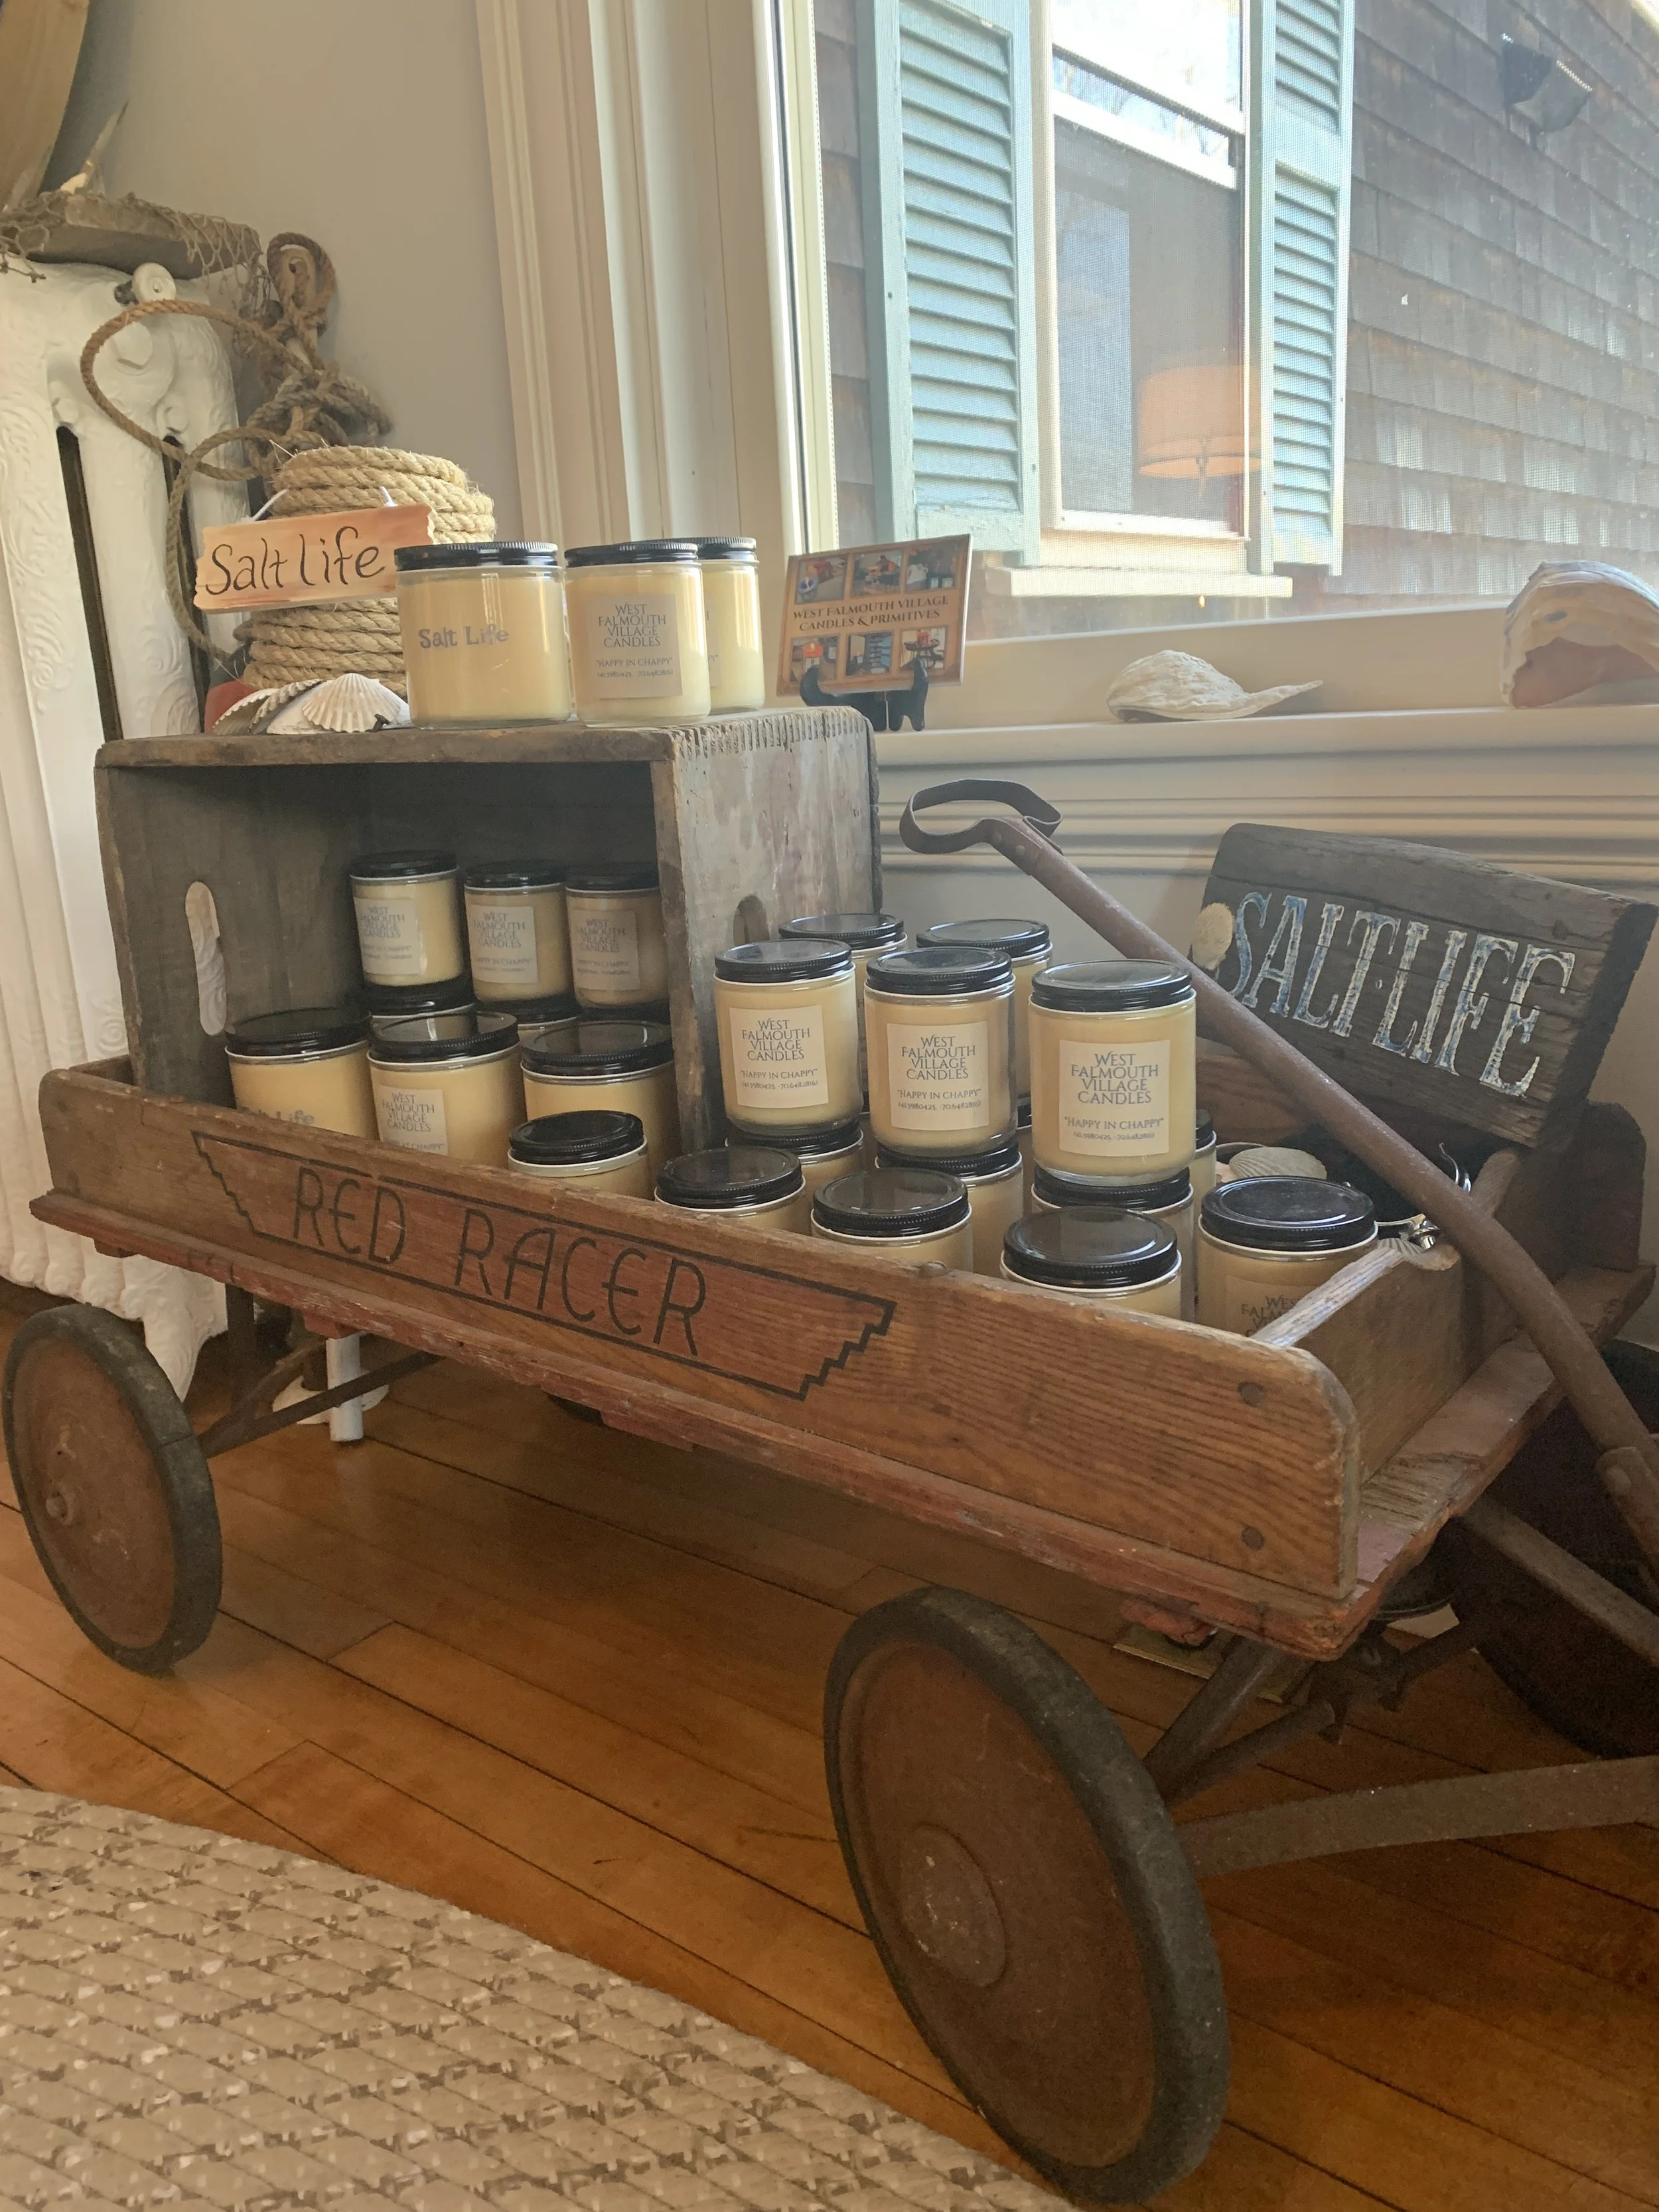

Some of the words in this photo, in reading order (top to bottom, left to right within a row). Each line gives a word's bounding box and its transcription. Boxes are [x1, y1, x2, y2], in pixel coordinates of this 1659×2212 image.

[206, 538, 287, 595] Salt
[615, 602, 648, 616] WEST
[794, 608, 826, 620] WEST
[827, 601, 894, 617] FALMOUTH
[899, 595, 949, 609] VILLAGE
[598, 615, 666, 627] FALMOUTH
[800, 617, 854, 631] CANDLES
[857, 617, 869, 627] &
[871, 610, 940, 625] PRIMITIVES
[418, 627, 457, 648] Salt
[465, 624, 509, 646] Life
[607, 625, 658, 637] VILLAGE
[603, 636, 660, 648] CANDLES
[1216, 892, 1401, 1037] SALT
[1372, 921, 1575, 1098] LIFE
[758, 1017, 790, 1031] WEST
[742, 1028, 810, 1041] FALMOUTH
[750, 1039, 802, 1051] VILLAGE
[921, 1035, 956, 1049] WEST
[747, 1049, 804, 1061] CANDLES
[901, 1045, 975, 1059] FALMOUTH
[911, 1057, 966, 1069] VILLAGE
[1094, 1051, 1136, 1068] WEST
[741, 1070, 766, 1078] "HAPPY
[780, 1069, 818, 1078] CHAPPY"
[906, 1068, 969, 1080] CANDLES
[1071, 1065, 1159, 1079] FALMOUTH
[1081, 1078, 1147, 1092] VILLAGE
[392, 1092, 416, 1104] WEST
[897, 1089, 927, 1099] "HAPPY
[942, 1088, 981, 1099] CHAPPY"
[1078, 1090, 1151, 1104] CANDLES
[382, 1099, 434, 1114] FALMOUTH
[388, 1110, 427, 1123] VILLAGE
[1064, 1116, 1101, 1129] "HAPPY
[1104, 1121, 1116, 1130] IN
[1119, 1118, 1164, 1130] CHAPPY"
[387, 1118, 431, 1132] CANDLES
[293, 1166, 405, 1264] RED
[455, 1209, 706, 1357] RACER
[1264, 1295, 1301, 1309] WES
